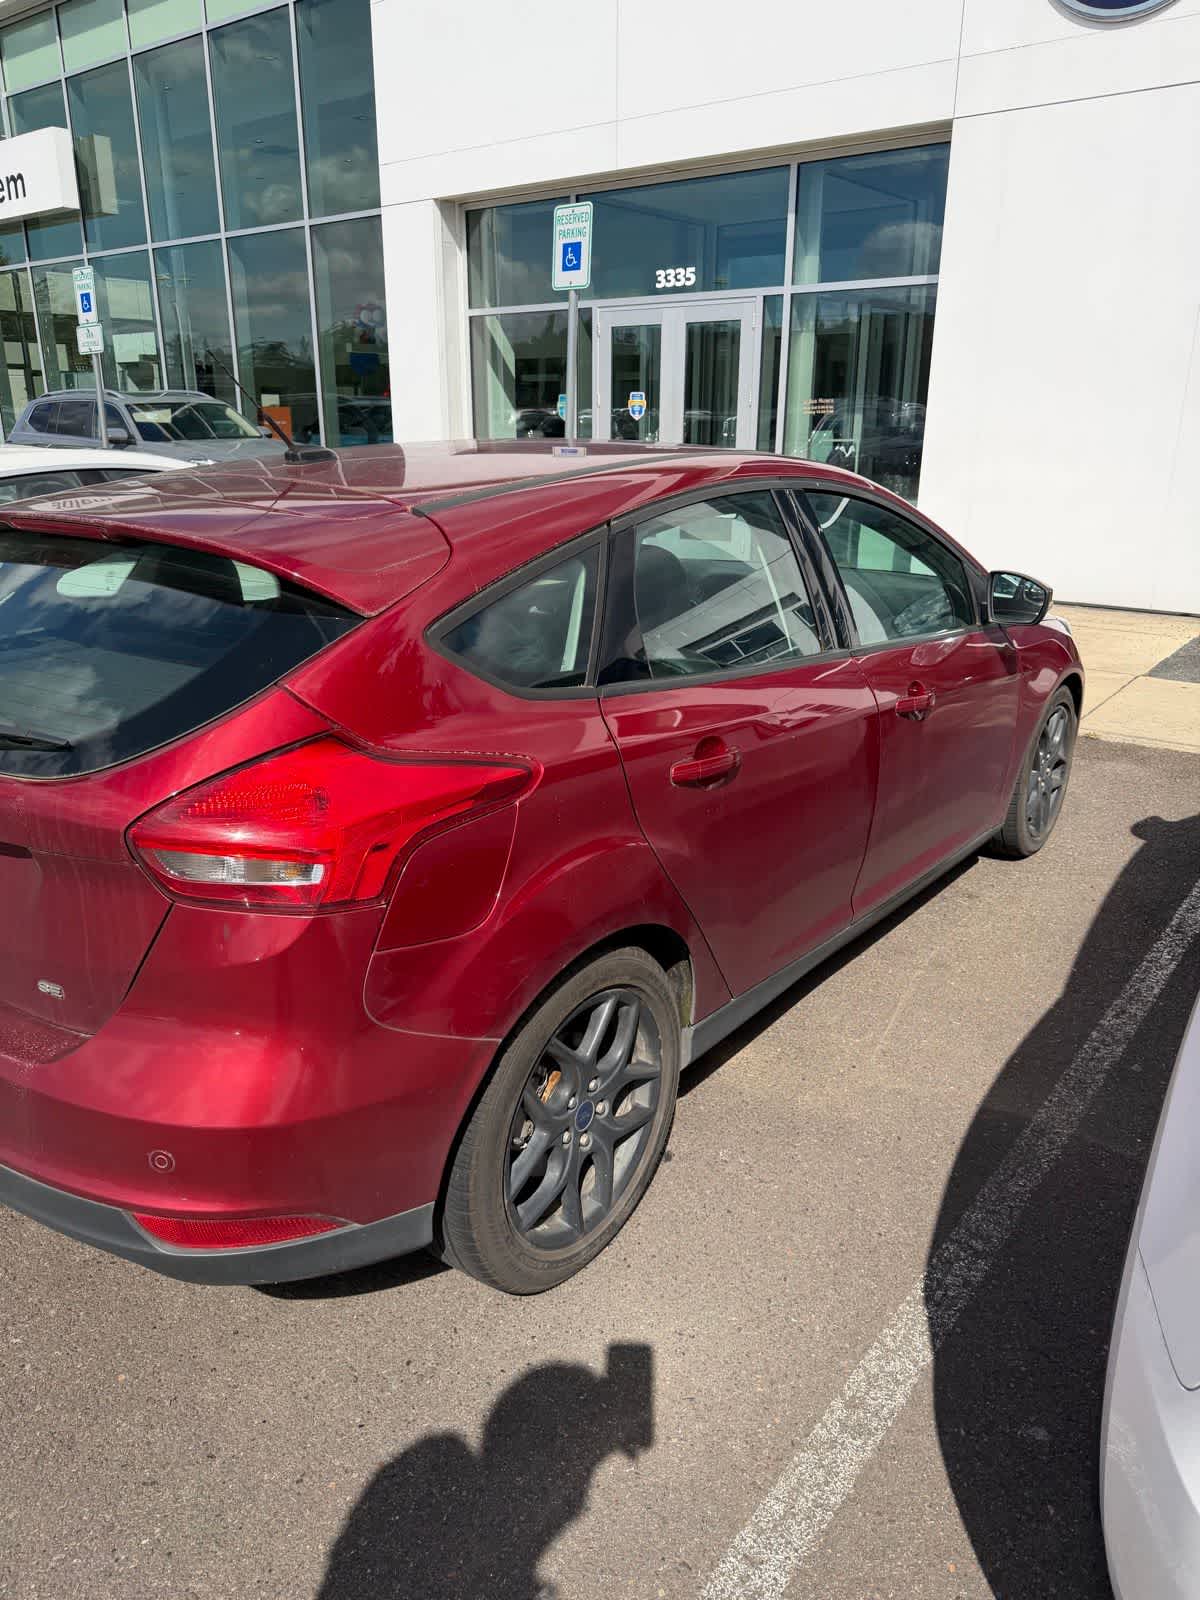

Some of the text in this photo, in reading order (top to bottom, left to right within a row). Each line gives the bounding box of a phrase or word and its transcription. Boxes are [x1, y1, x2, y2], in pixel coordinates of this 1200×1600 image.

[556, 211, 589, 225] RESERVED
[559, 227, 587, 240] PARKING
[655, 266, 696, 288] 3335
